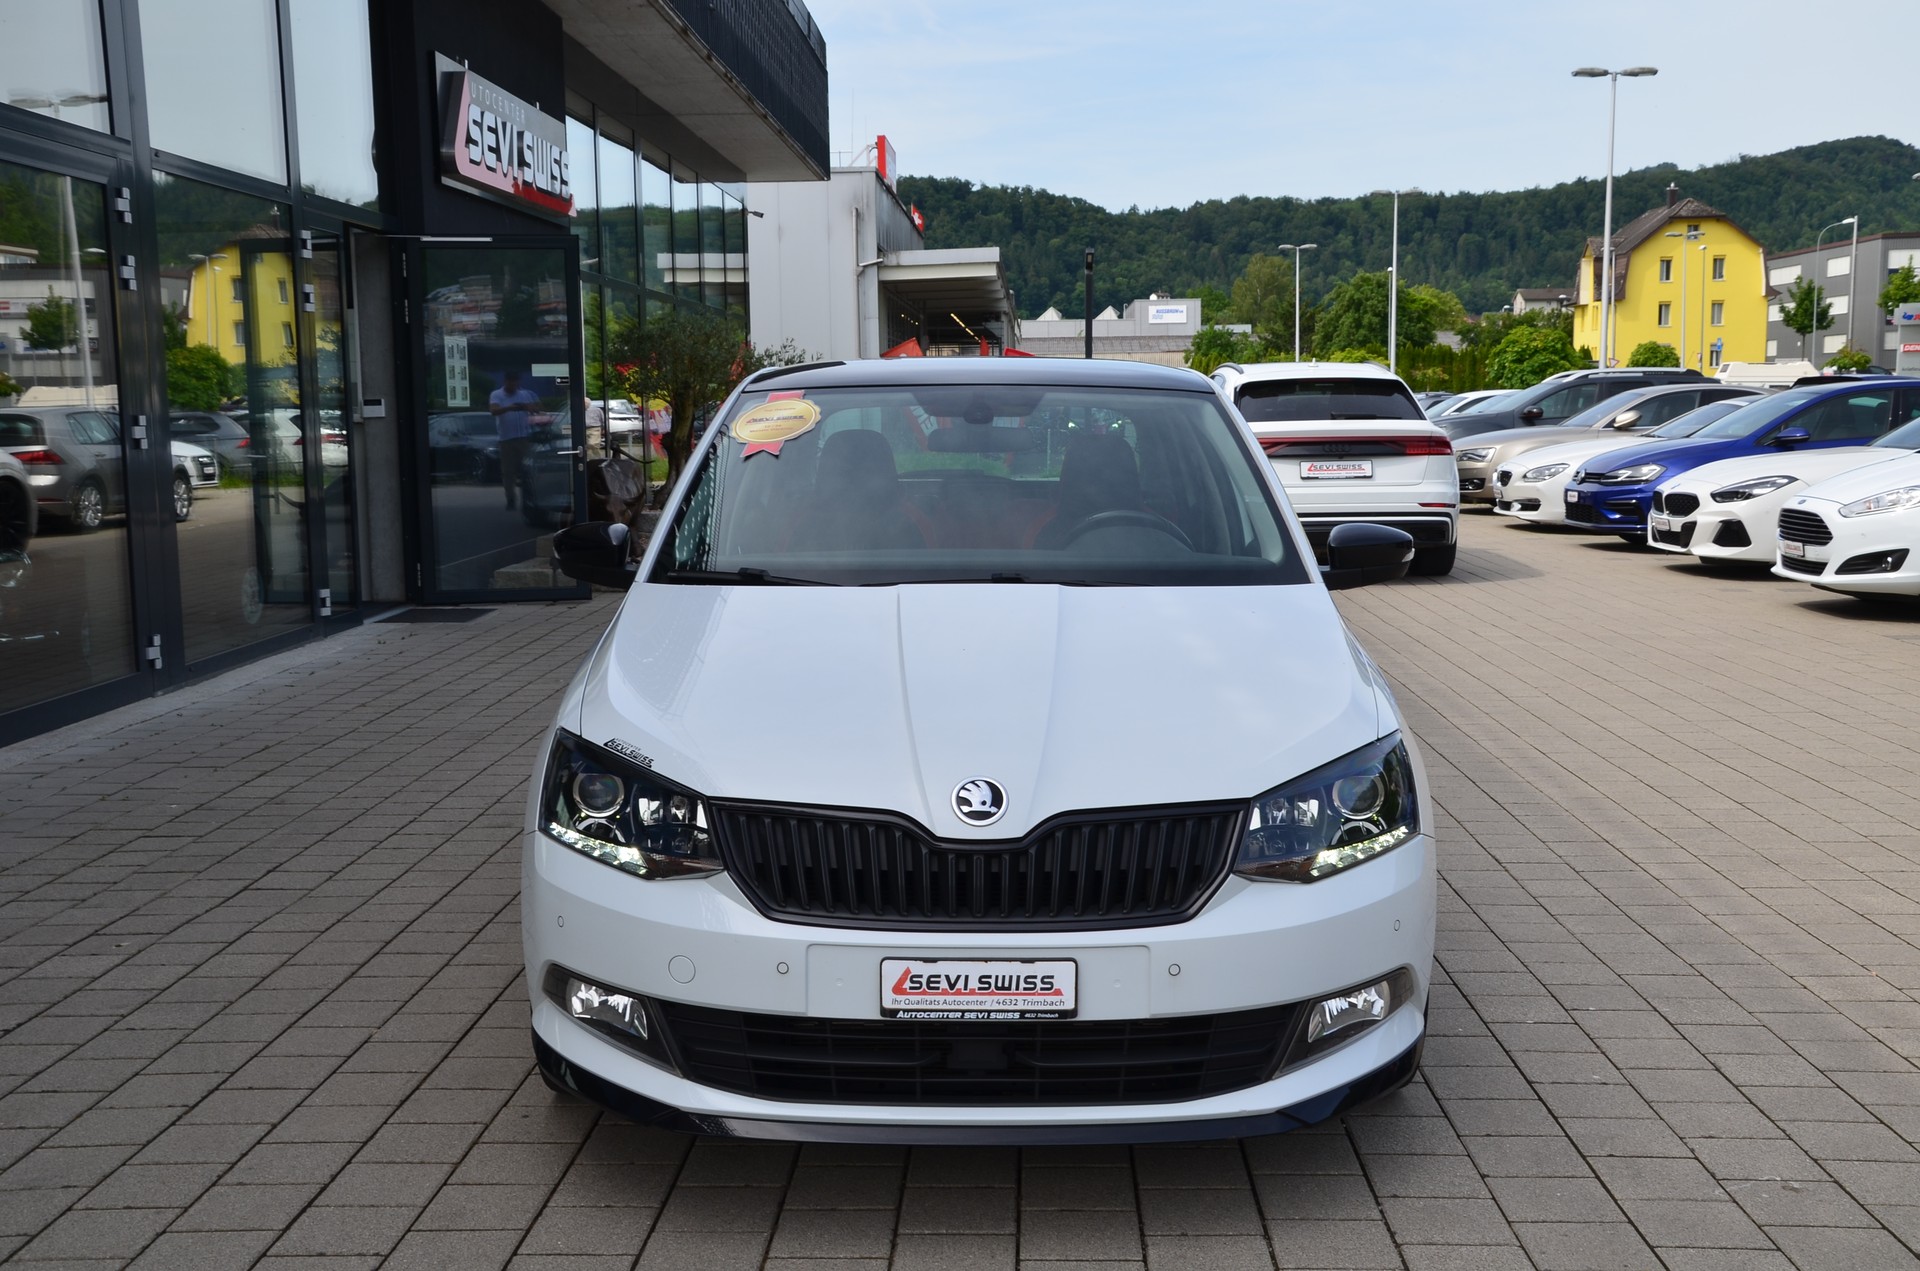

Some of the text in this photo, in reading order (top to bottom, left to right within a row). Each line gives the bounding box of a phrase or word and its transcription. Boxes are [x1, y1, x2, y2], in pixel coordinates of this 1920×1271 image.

[522, 130, 571, 199] SWISS
[628, 749, 655, 766] SWISS
[908, 974, 1055, 991] SEVI SWISS
[891, 998, 903, 1006] Ihr
[942, 998, 987, 1006] Autocenter
[996, 998, 1019, 1006] 4632
[1021, 998, 1065, 1007] Trimbach
[963, 1011, 987, 1019] SEVI
[989, 1011, 1020, 1019] SWISS
